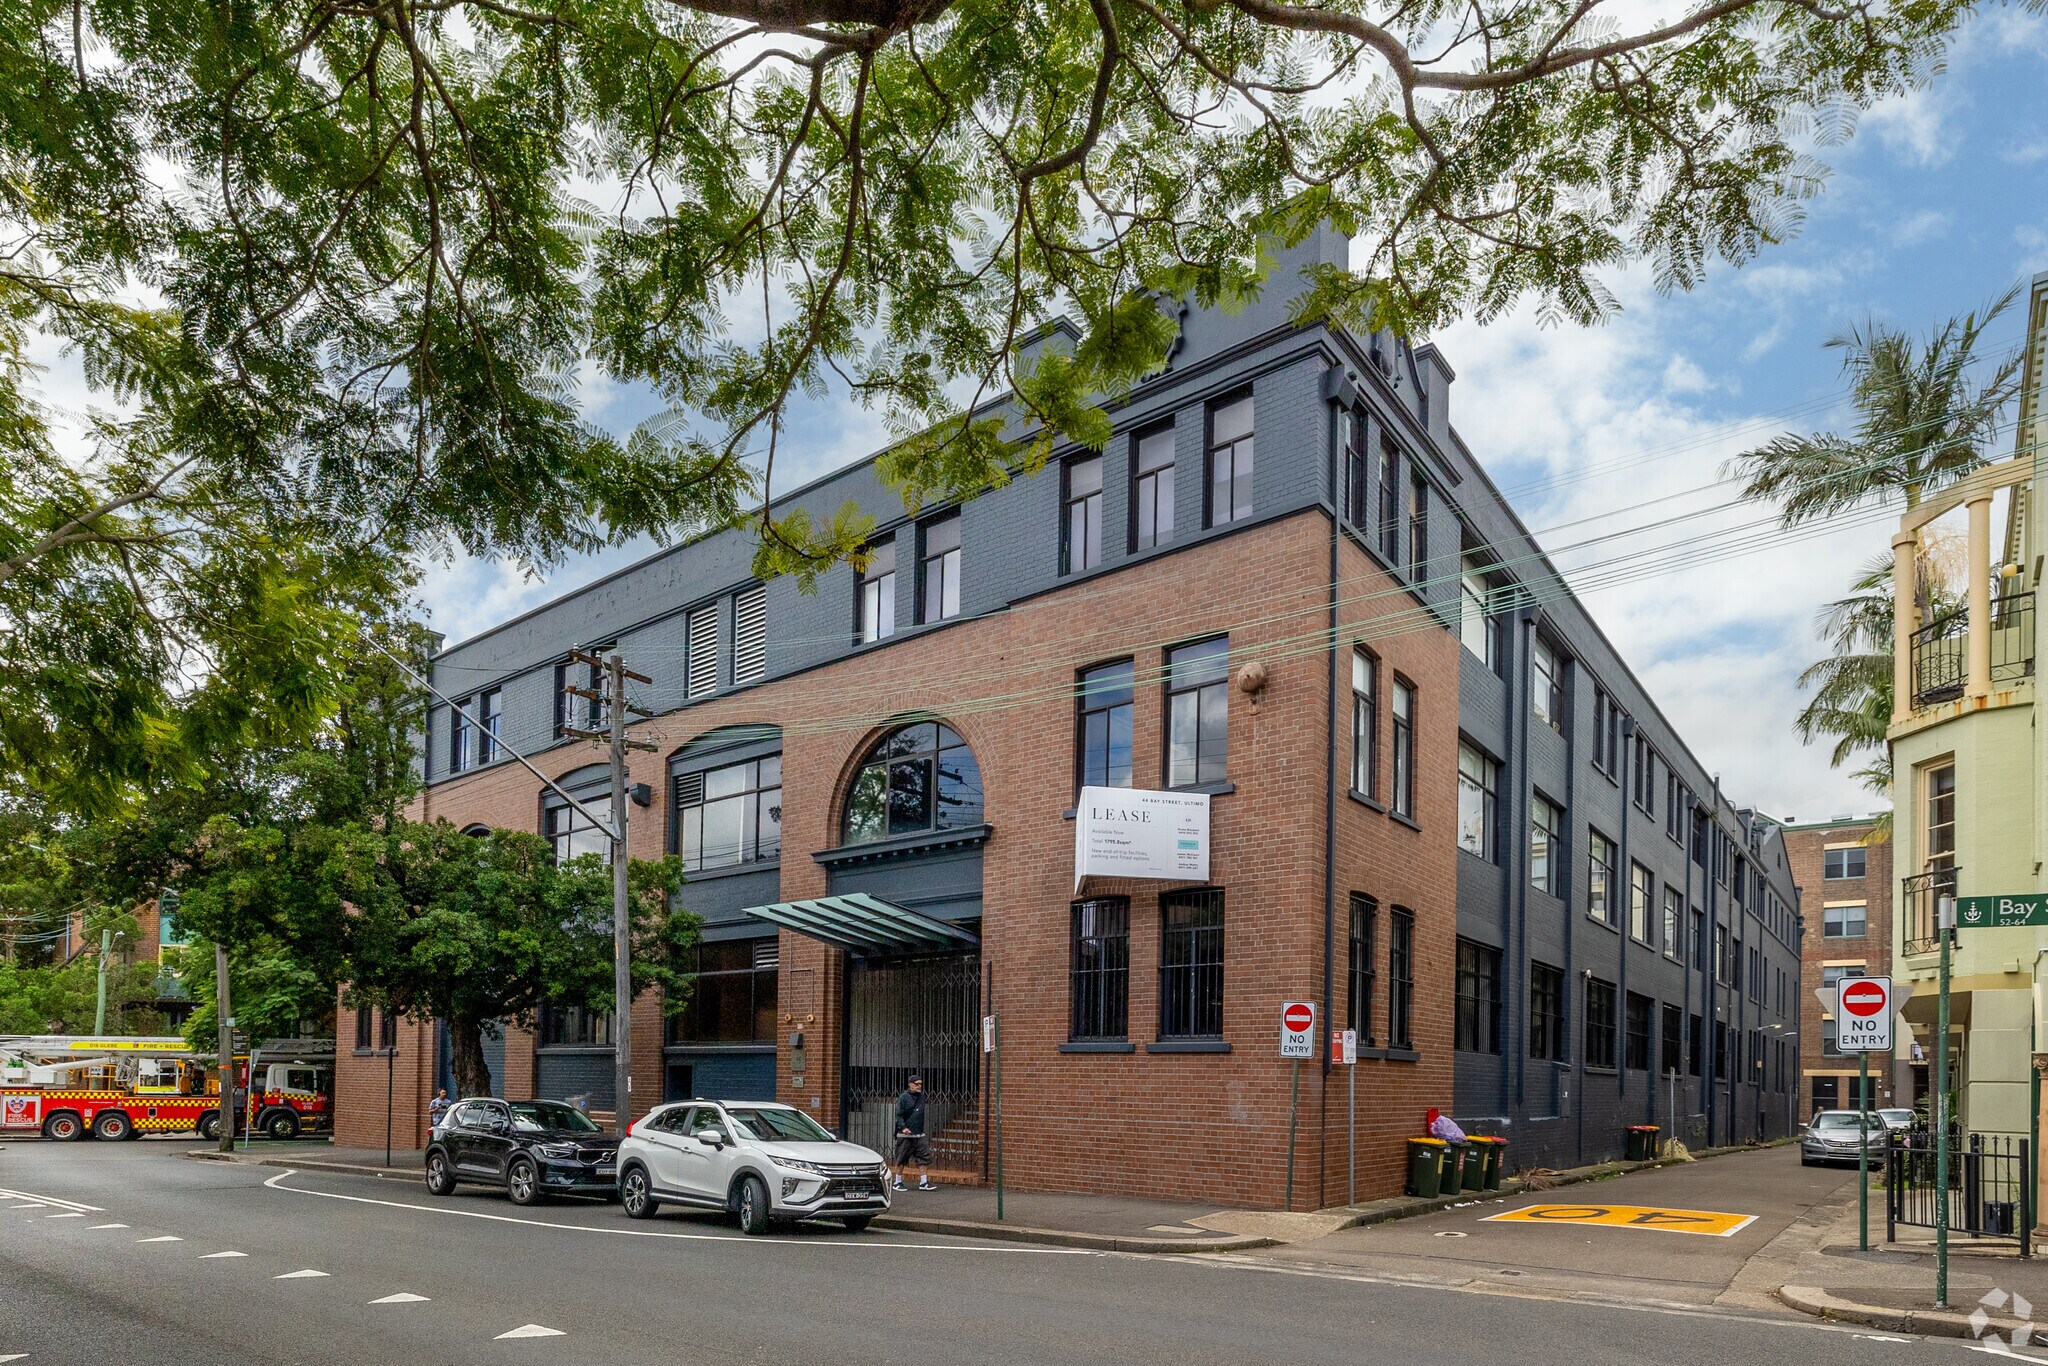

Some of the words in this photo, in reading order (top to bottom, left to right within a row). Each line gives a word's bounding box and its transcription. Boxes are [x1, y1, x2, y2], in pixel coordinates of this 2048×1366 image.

[1093, 807, 1151, 823] LEASE
[2000, 899, 2038, 919] Bay
[1852, 1020, 1877, 1031] NO
[1289, 1034, 1305, 1044] NO
[1842, 1035, 1886, 1044] ENTRY
[1283, 1045, 1309, 1053] ENTRY
[1527, 1208, 1715, 1224] 40
